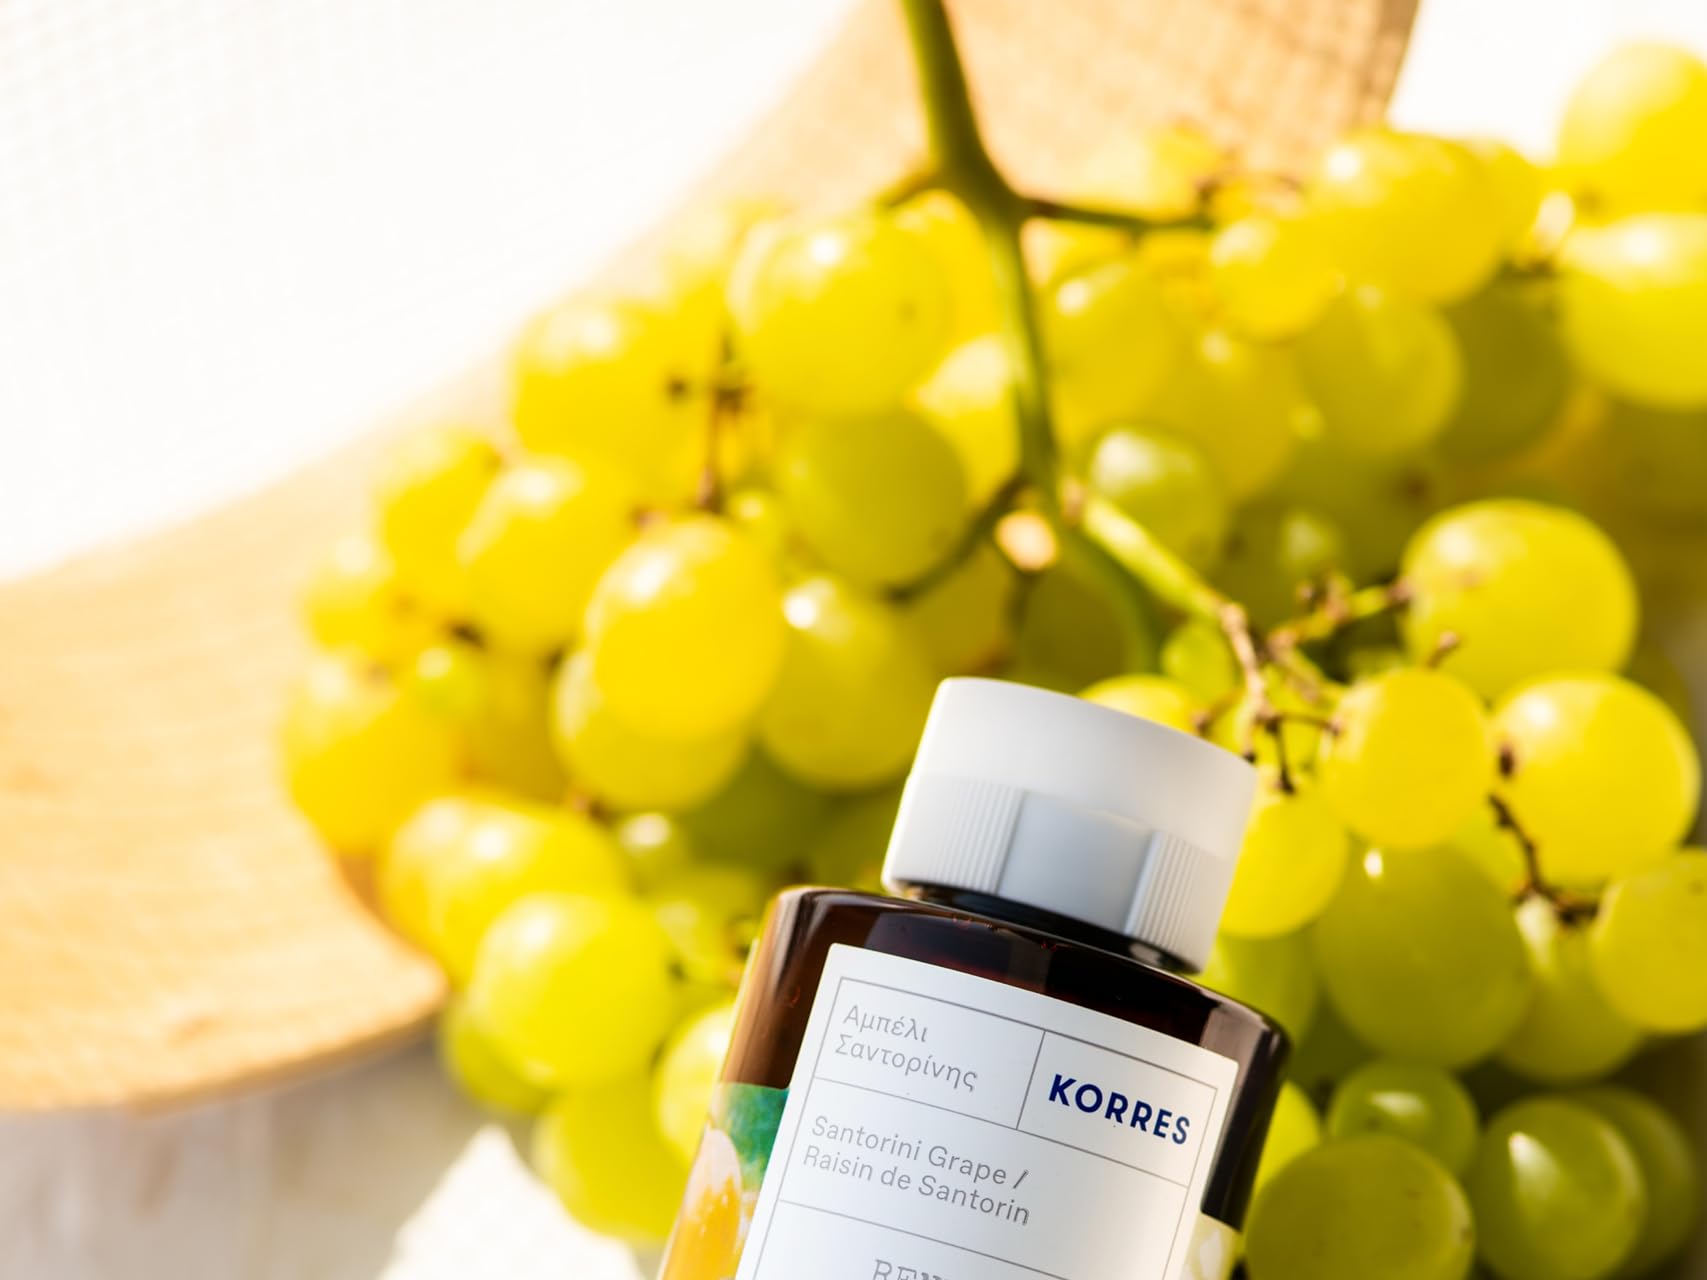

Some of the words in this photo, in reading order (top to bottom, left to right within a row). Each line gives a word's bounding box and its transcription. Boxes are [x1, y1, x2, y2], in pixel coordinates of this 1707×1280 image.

[842, 1005, 928, 1042] Αμπέλι
[834, 1034, 978, 1093] Σαντορίνης
[1048, 1074, 1191, 1146] KORRES
[802, 1146, 873, 1181] Raisin
[880, 1167, 910, 1191] de
[918, 1175, 1030, 1226] Santorin
[812, 1115, 922, 1162] Santorini
[928, 1146, 1007, 1190] Grape
